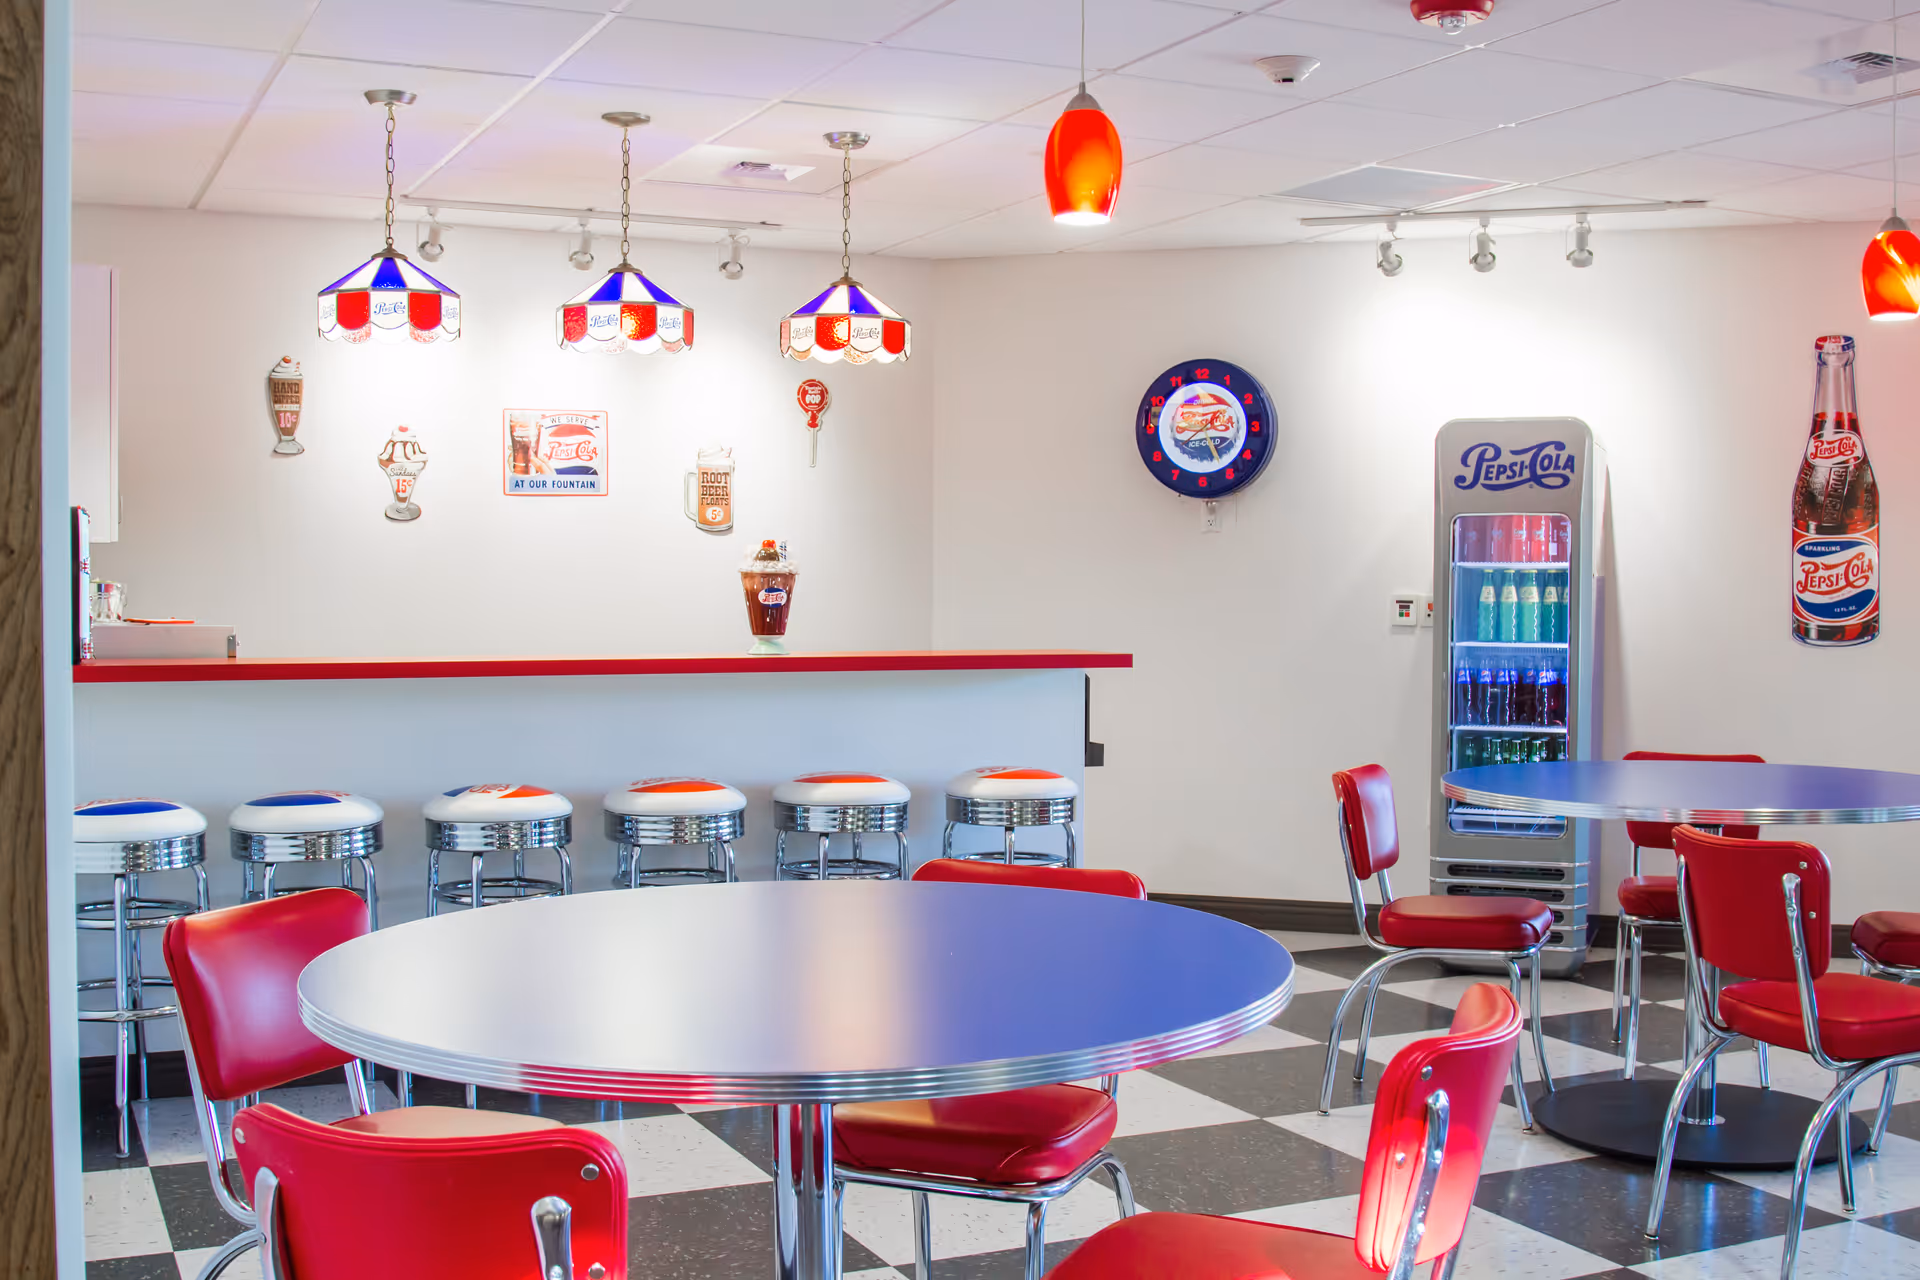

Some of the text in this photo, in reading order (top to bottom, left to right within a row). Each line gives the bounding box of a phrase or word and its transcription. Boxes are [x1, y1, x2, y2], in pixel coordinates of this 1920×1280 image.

[1195, 368, 1210, 379] 12
[1170, 376, 1182, 387] 11
[1224, 375, 1231, 385] 1
[273, 382, 300, 394] HAND
[805, 394, 821, 404] POP
[1151, 396, 1165, 407] 10
[1244, 393, 1253, 404] 2
[550, 416, 588, 425] WE SERVE
[1146, 424, 1155, 434] 9
[1251, 421, 1260, 432] 3
[1153, 451, 1162, 462] 8
[1242, 449, 1252, 460] 4
[701, 472, 730, 484] ROOT
[1172, 470, 1180, 480] 7
[1226, 469, 1234, 479] 5
[514, 480, 596, 489] AT OUR FOUNTAIN
[1198, 477, 1207, 487] 6
[701, 485, 729, 497] BEER
[700, 497, 729, 506] FLOATS
